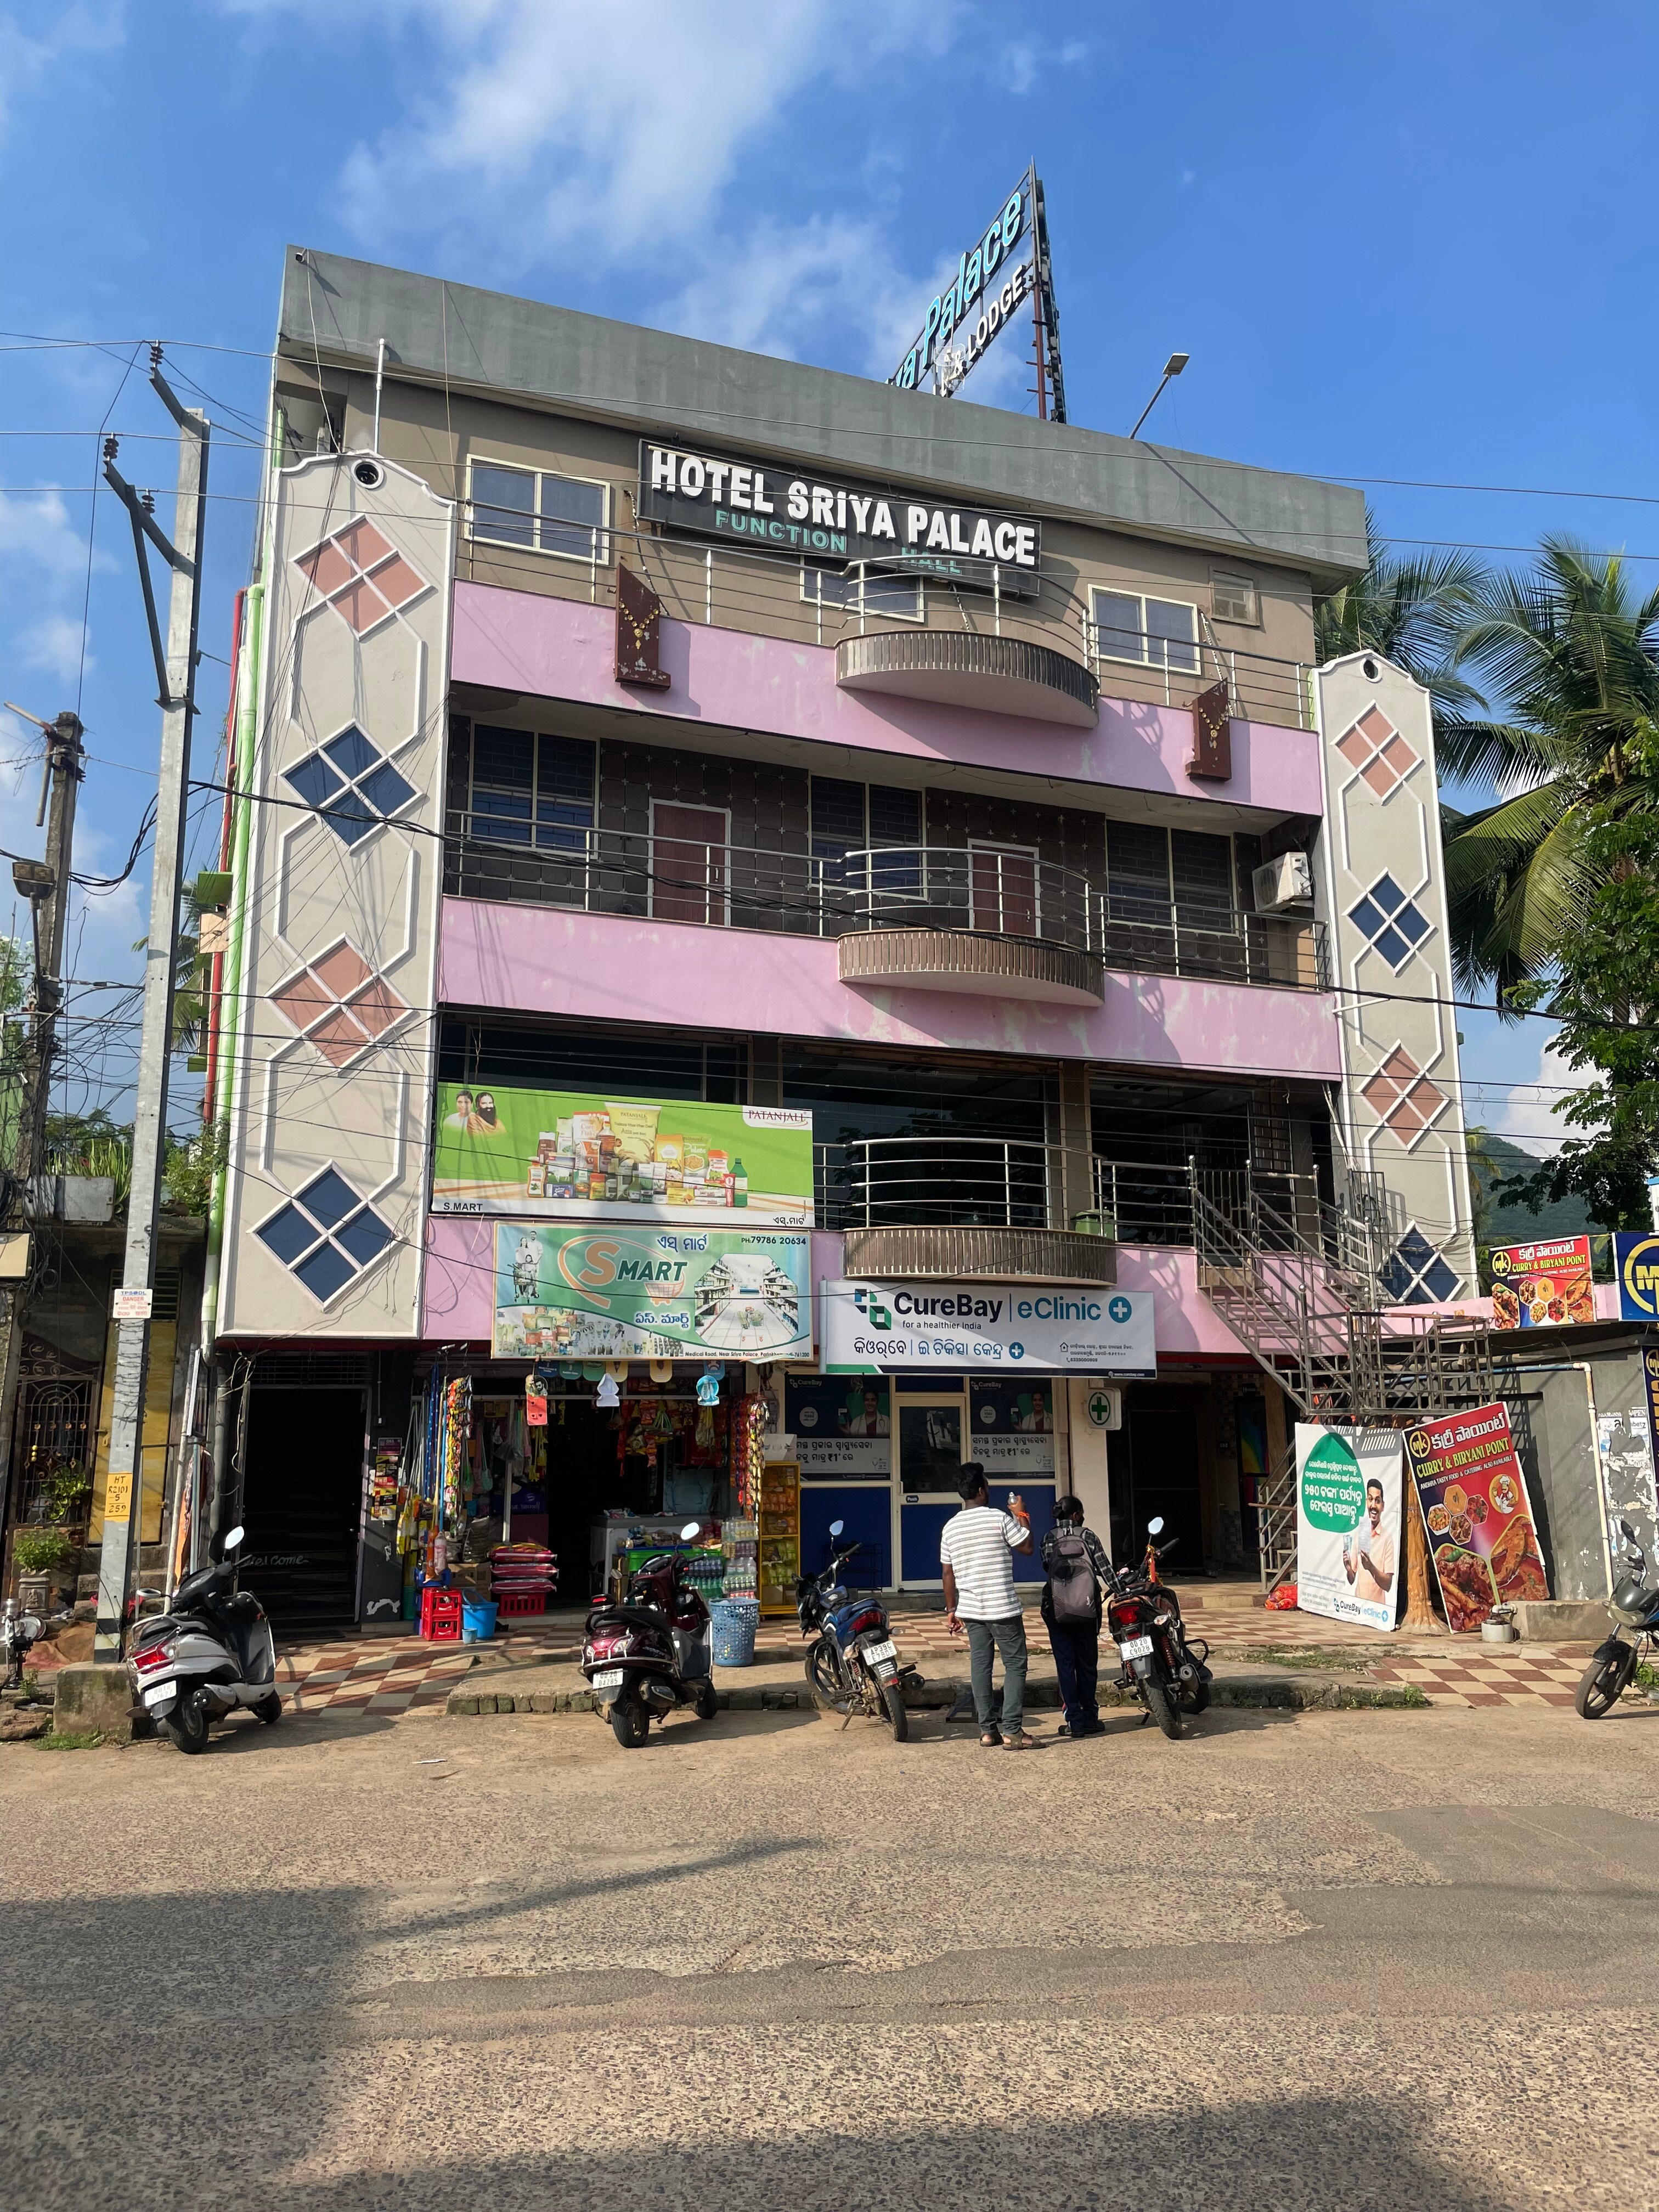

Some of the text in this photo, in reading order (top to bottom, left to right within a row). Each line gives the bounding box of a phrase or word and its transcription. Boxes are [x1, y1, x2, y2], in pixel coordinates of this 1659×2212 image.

[923, 191, 1024, 370] Palace
[968, 264, 1026, 362] LODGE
[651, 450, 1036, 566] HOTEL SRIYA PALACE
[715, 510, 848, 553] FUNCTION
[749, 1110, 805, 1123] PATANJALI
[443, 1202, 483, 1211] S.MART
[683, 1234, 707, 1251] ମାର୍ଟ
[780, 1237, 806, 1246] 20634
[1512, 1254, 1586, 1272] CURRY & BIRYANI POINT
[894, 1292, 1101, 1323] CureBay eClinic
[902, 1321, 913, 1329] for
[923, 1321, 960, 1330] healthier
[962, 1322, 982, 1330] India
[1416, 1437, 1510, 1478] CURRY & BIRYANI POINT
[1437, 1475, 1448, 1485] TASTY
[1449, 1472, 1459, 1481] FOOD
[1464, 1465, 1482, 1475] CATERING
[1493, 1455, 1513, 1466] AVAILABLE
[109, 1505, 127, 1513] 259
[1340, 1601, 1361, 1615] CureBay
[1363, 1607, 1381, 1619] eClinic
